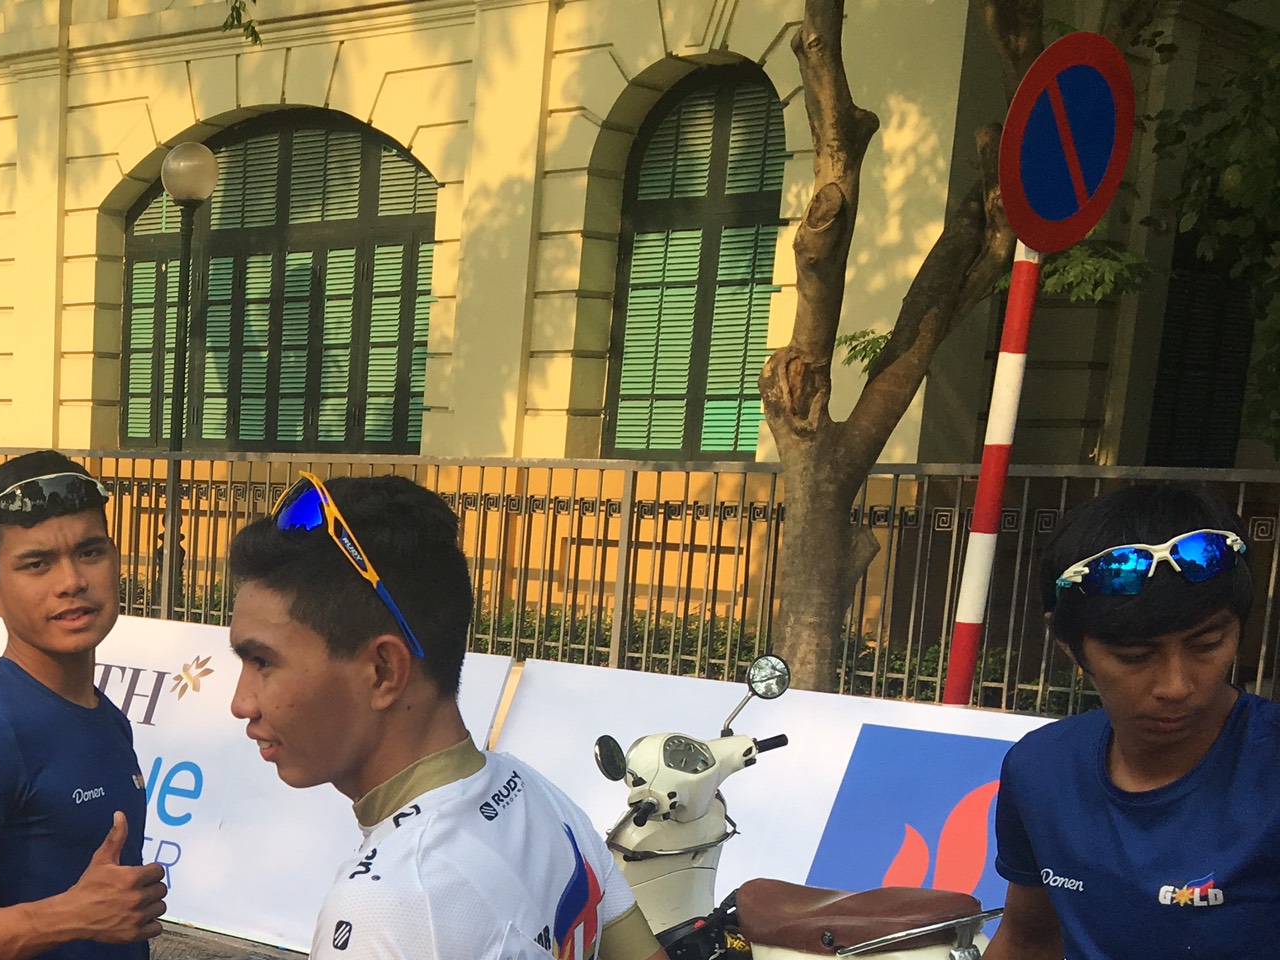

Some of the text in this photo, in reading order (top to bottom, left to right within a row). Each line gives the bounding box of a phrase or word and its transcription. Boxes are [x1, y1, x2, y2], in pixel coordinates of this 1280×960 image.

[72, 786, 106, 805] Donen
[491, 769, 522, 807] RUDY
[1040, 868, 1085, 892] Donen
